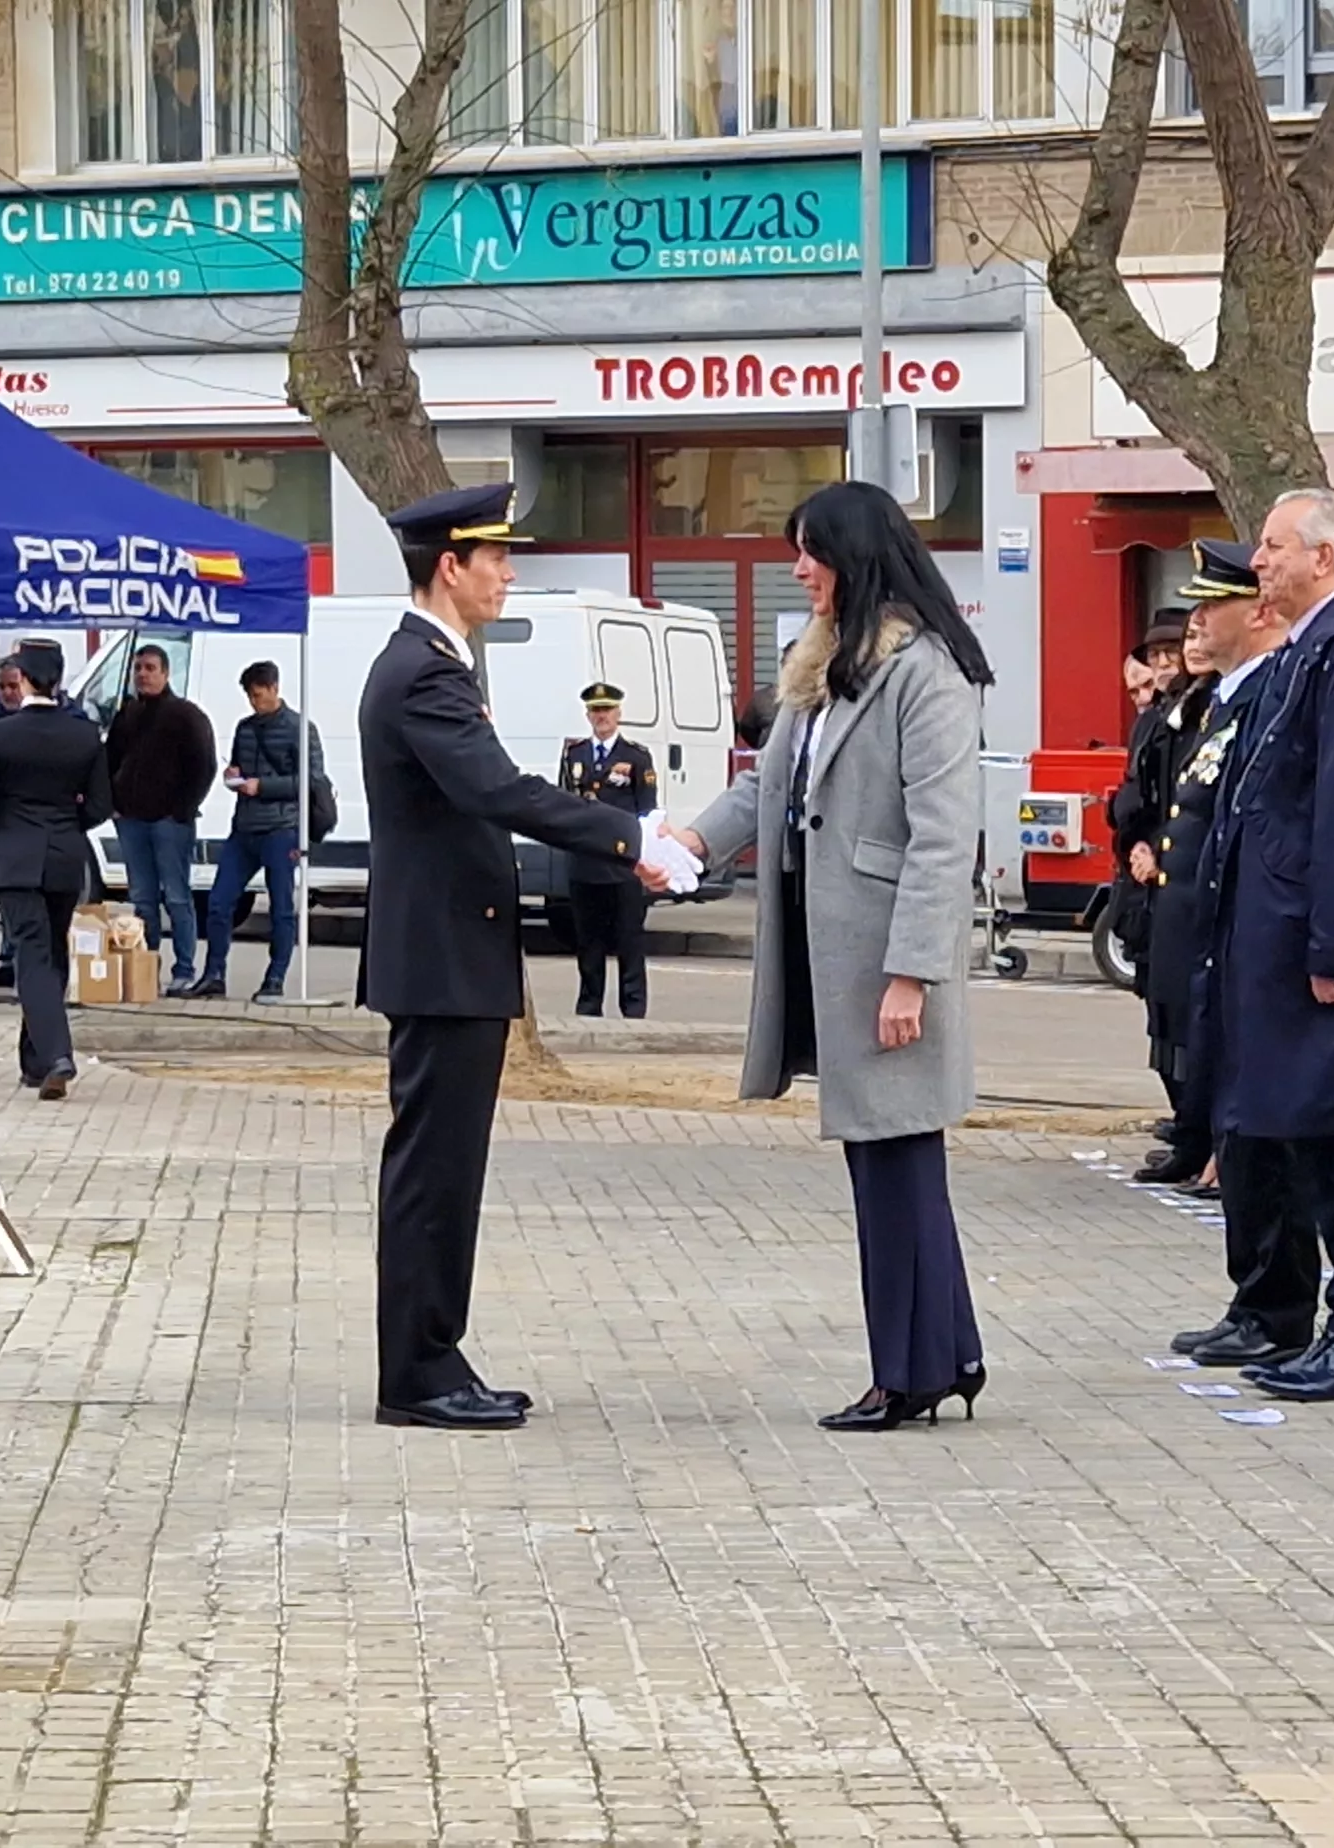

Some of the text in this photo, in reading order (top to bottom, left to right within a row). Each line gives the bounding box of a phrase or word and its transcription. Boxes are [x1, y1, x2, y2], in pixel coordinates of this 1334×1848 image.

[0, 195, 196, 244] CLINICA
[484, 170, 821, 272] Verguizas
[658, 240, 860, 268] ESTOMATOLOGÍA
[13, 534, 198, 579] POLICIA
[15, 577, 241, 624] NACIONAL
